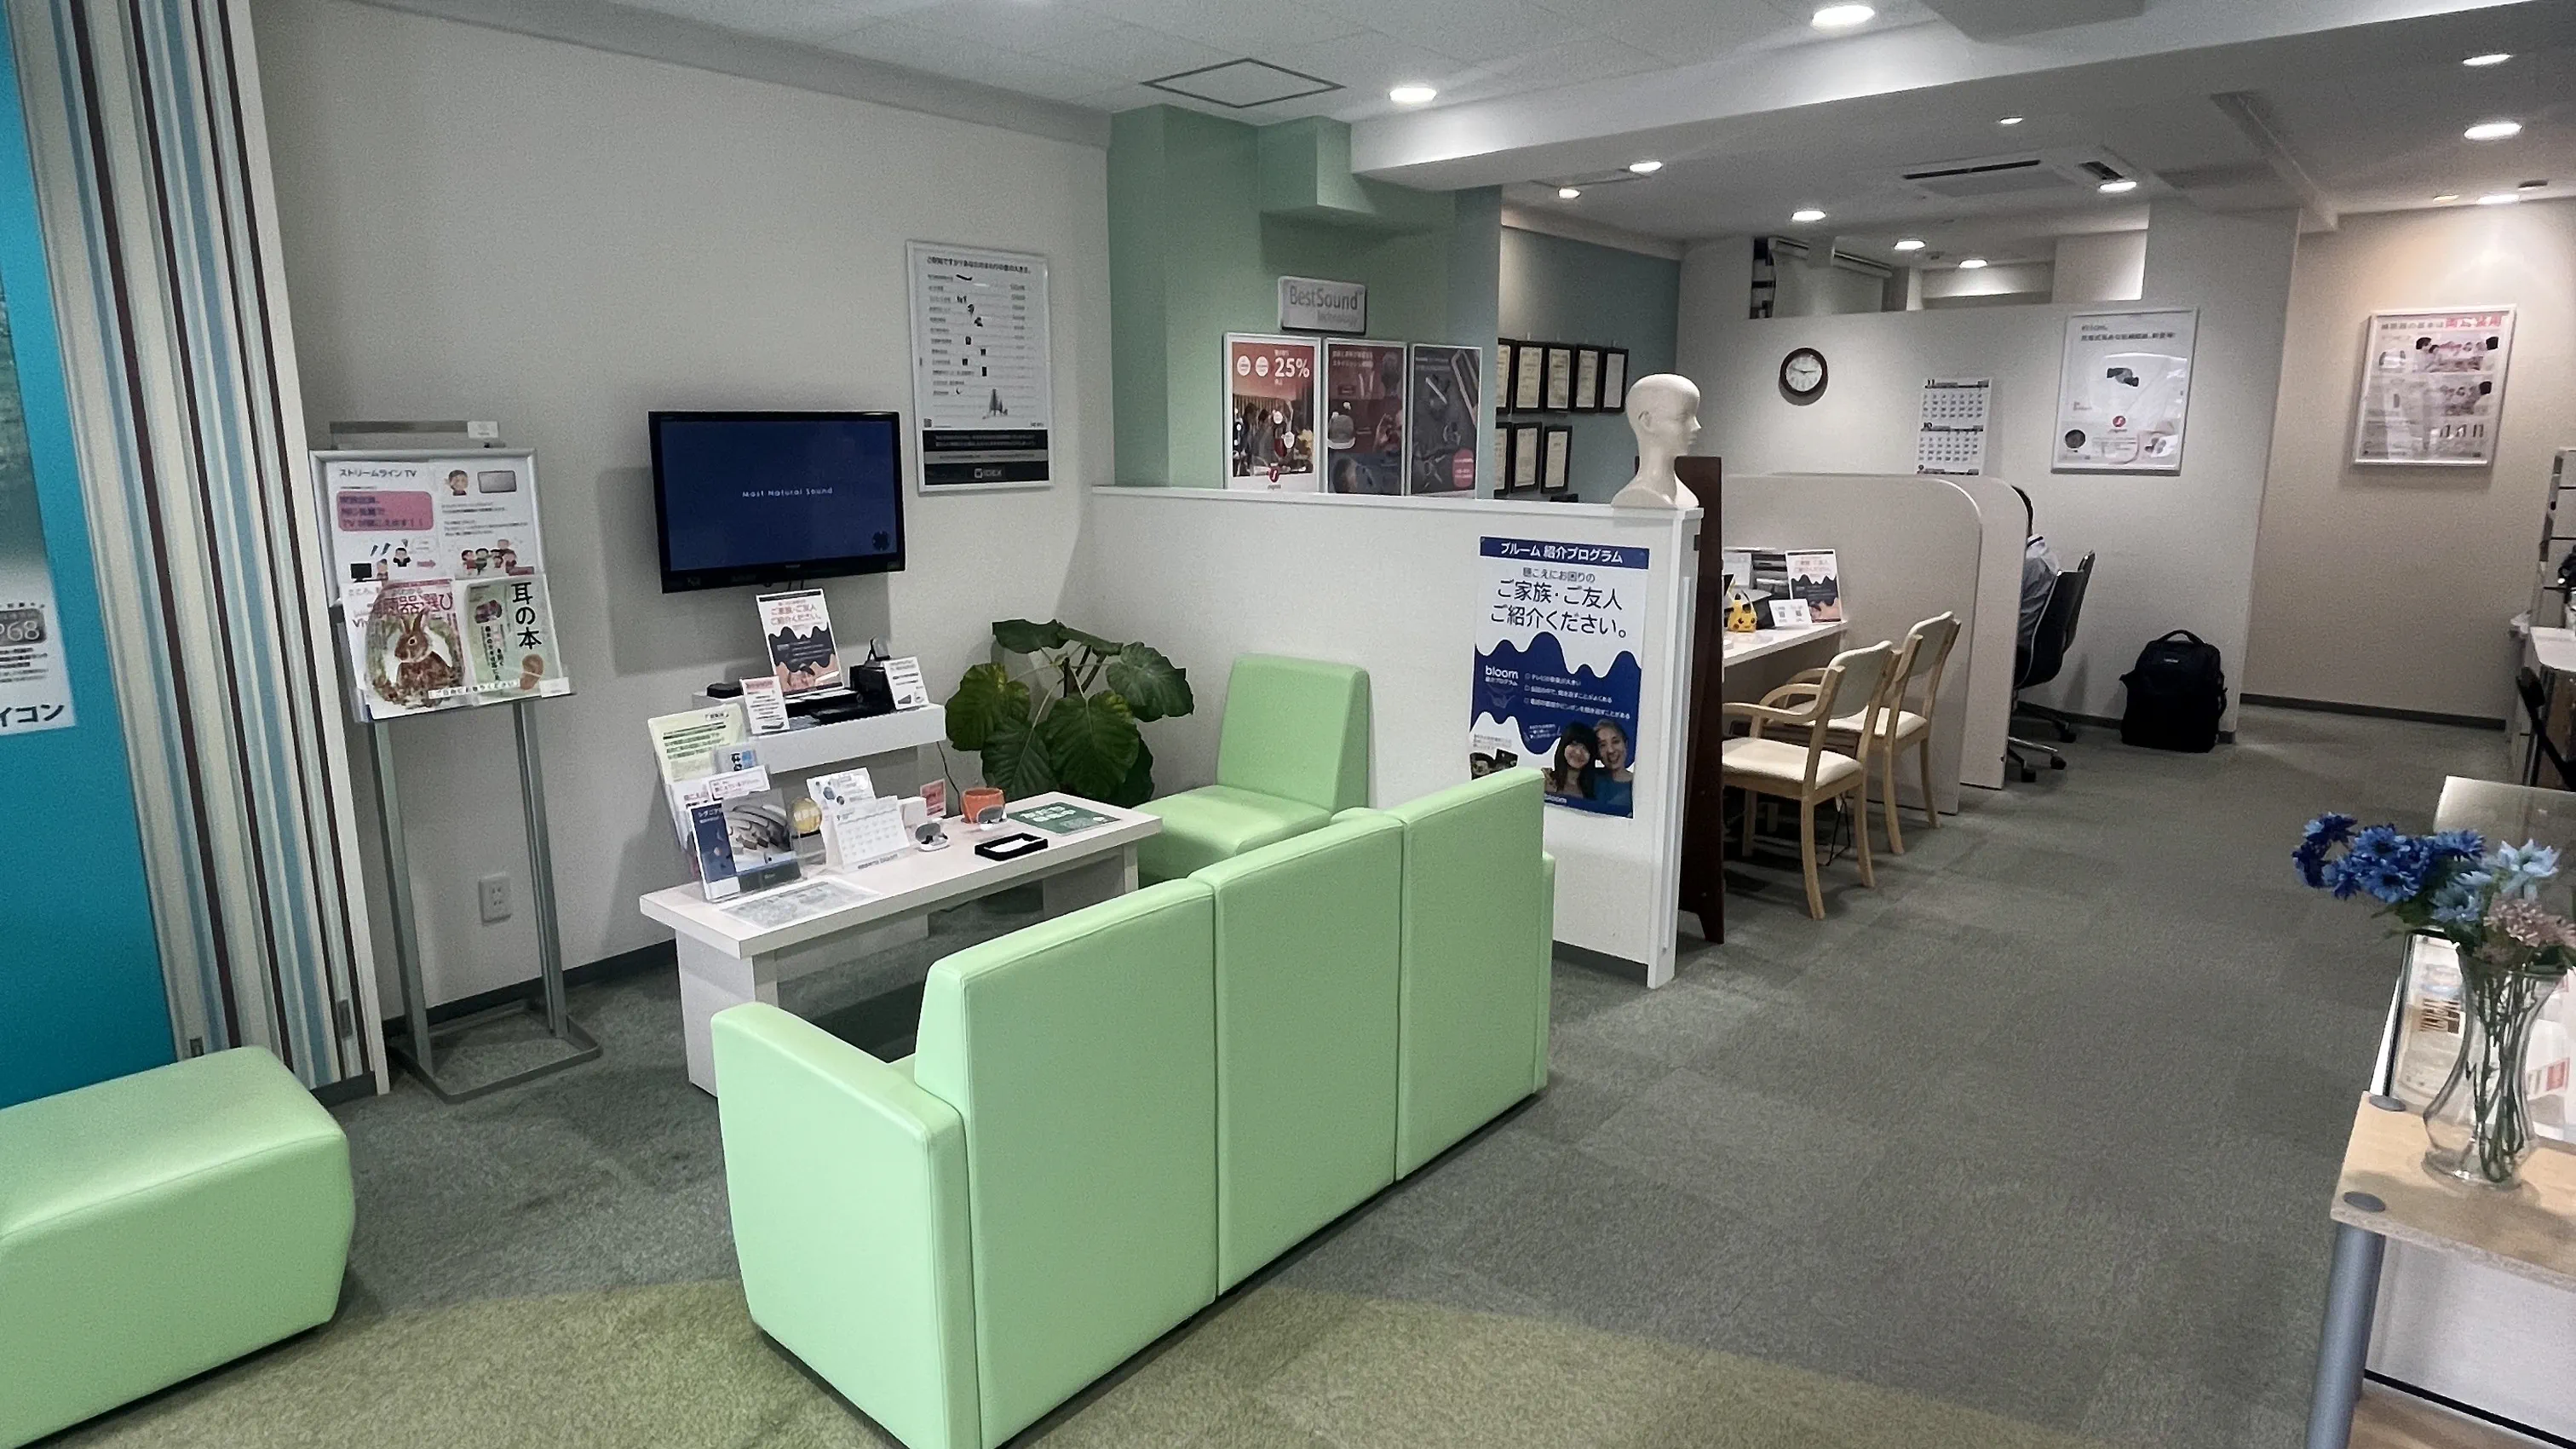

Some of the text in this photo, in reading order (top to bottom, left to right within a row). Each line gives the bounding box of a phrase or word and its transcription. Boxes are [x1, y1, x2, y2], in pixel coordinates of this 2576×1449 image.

[1289, 285, 1358, 310] BestSound
[1274, 357, 1310, 378] 25%
[742, 486, 833, 498] Most Natural Sound
[1500, 542, 1624, 564] ブルーム 紹介プログラム
[1498, 578, 1623, 611] ご家族・ご友人
[511, 581, 543, 651] 耳の本
[1491, 603, 1627, 639] ご紹介ください。
[1485, 664, 1519, 681] bloom
